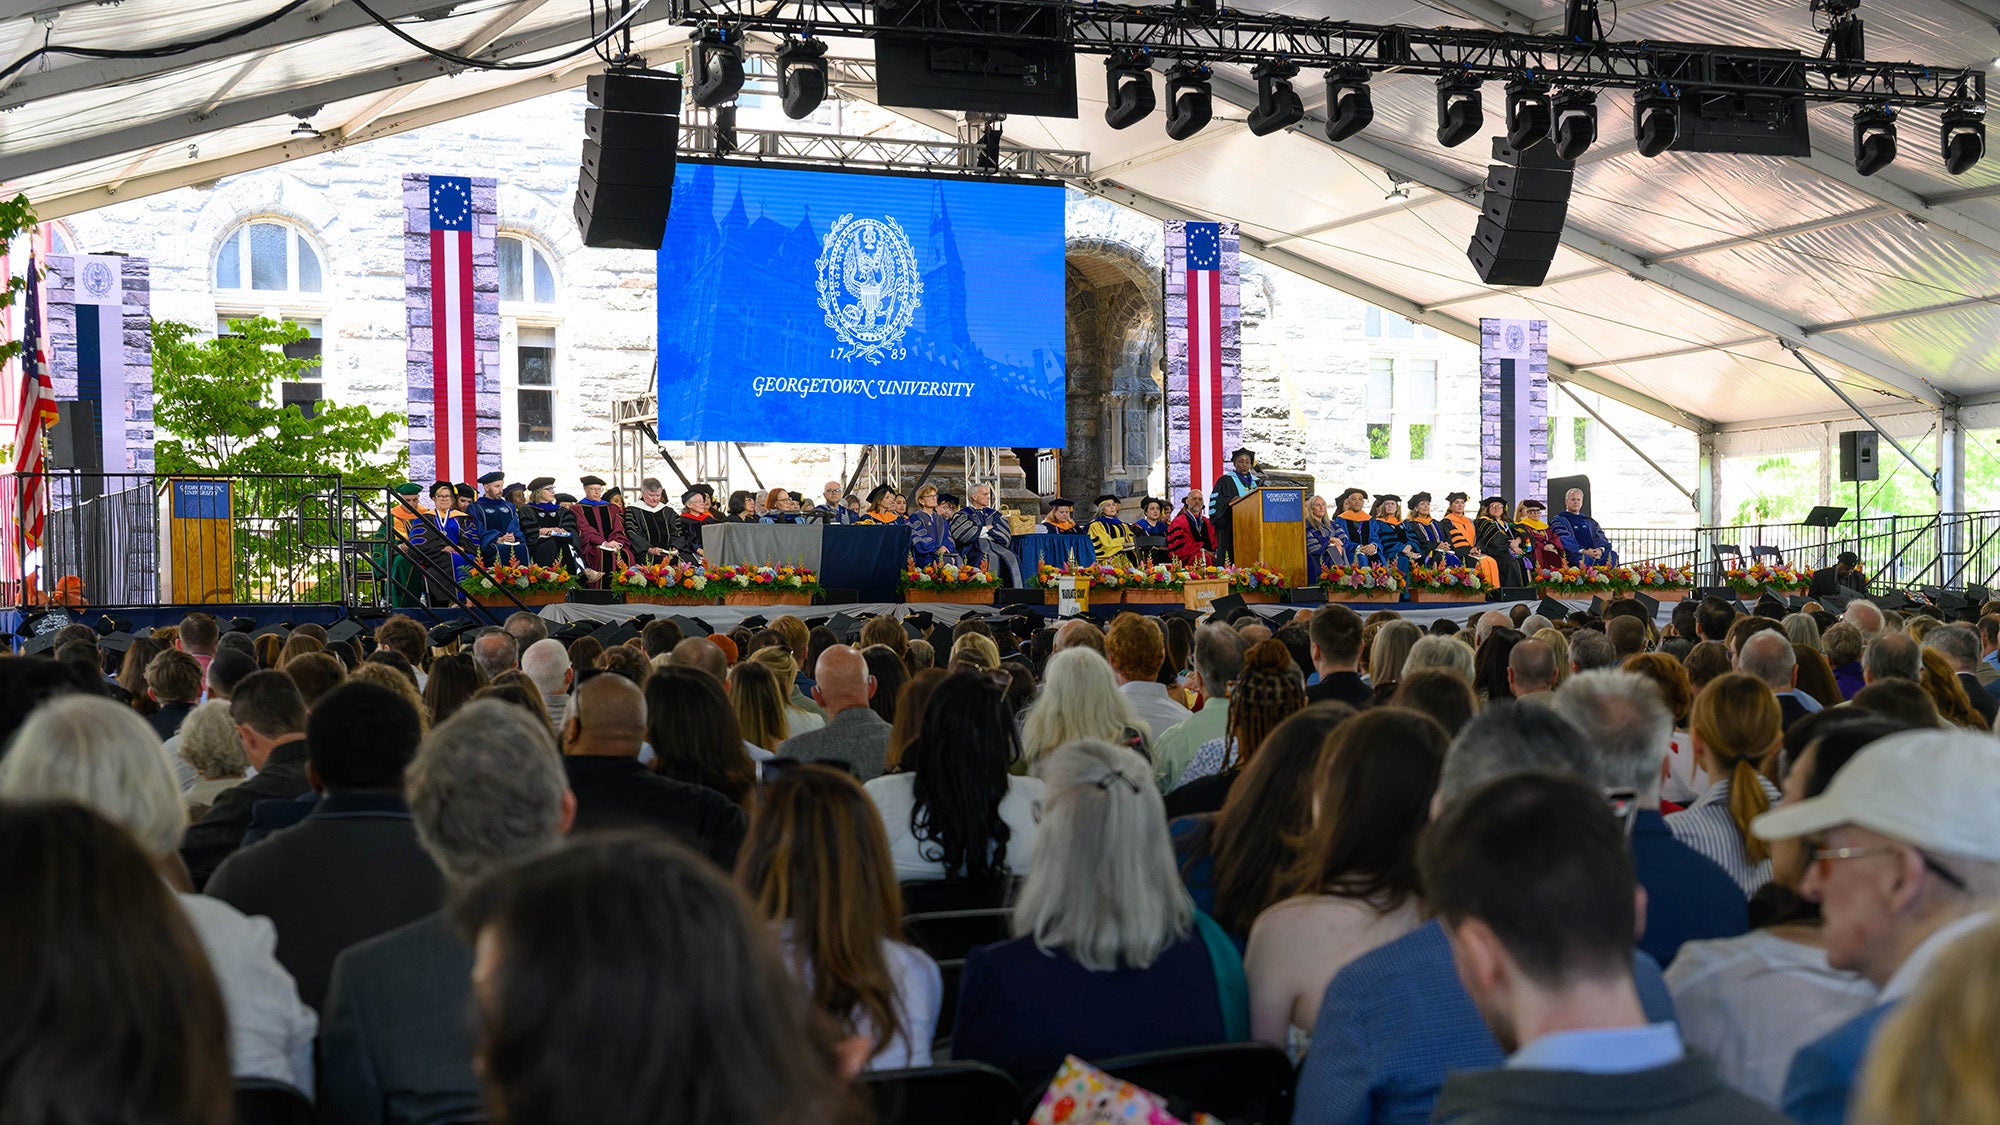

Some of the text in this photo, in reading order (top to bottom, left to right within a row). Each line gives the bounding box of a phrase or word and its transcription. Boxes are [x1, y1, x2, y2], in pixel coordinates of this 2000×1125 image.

[830, 348, 907, 361] 17 89
[753, 376, 975, 399] GEORGETOWN UNIVERSITY
